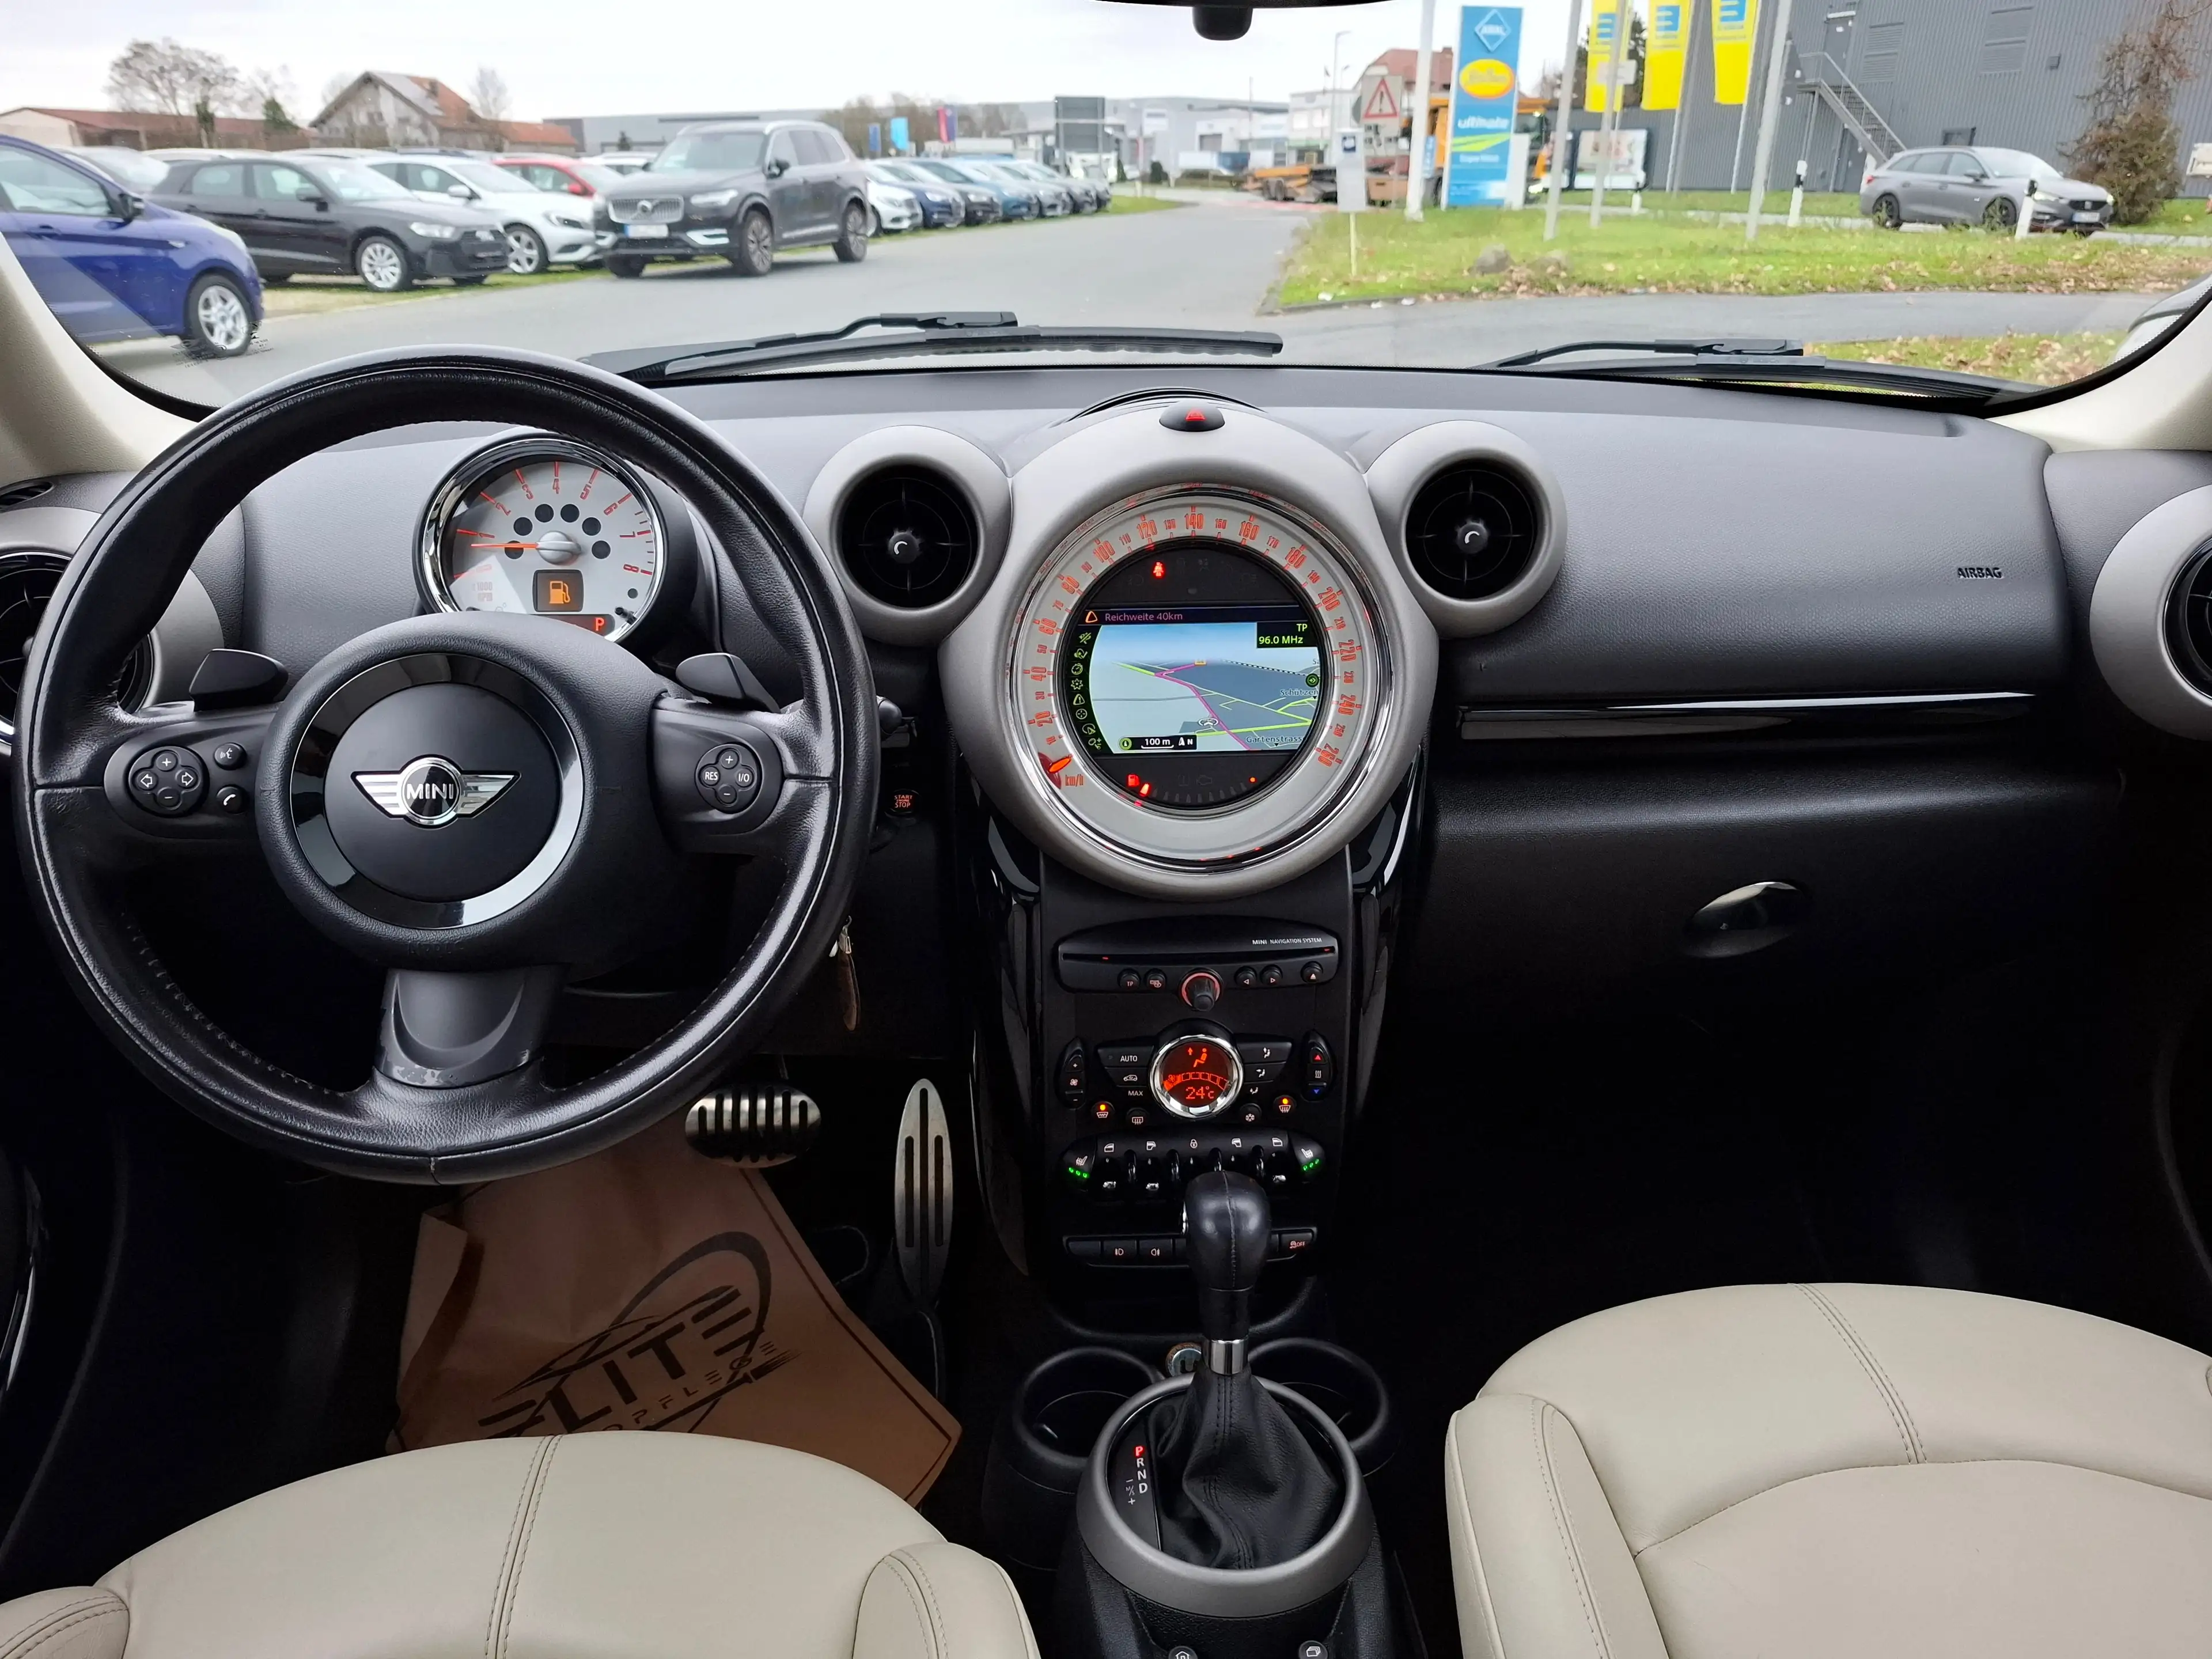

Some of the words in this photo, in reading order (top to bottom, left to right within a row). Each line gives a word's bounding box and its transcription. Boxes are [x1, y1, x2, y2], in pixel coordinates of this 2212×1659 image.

[521, 484, 533, 500] 3
[552, 479, 559, 494] 4
[579, 484, 591, 500] 5
[495, 502, 512, 516] 2
[603, 503, 619, 516] 6
[1184, 513, 1204, 529] 140
[1137, 520, 1158, 540] 120
[1238, 521, 1260, 540] 160
[1093, 540, 1116, 563] 100
[1285, 547, 1307, 569] 180
[623, 563, 640, 574] 8
[1957, 567, 2003, 579] AIRBAG
[1061, 575, 1080, 594] 80
[1317, 586, 1341, 611] 200
[595, 618, 604, 631] P
[1105, 612, 1154, 622] Reichweite
[1156, 612, 1183, 620] 40km
[1038, 618, 1058, 635] 60
[1297, 623, 1308, 632] TP
[1259, 636, 1279, 645] 96.0
[1282, 635, 1304, 645] MHz
[1338, 639, 1357, 662] 220
[1031, 666, 1047, 681] 40
[1338, 694, 1357, 715] 240
[1035, 711, 1053, 727] 20
[1318, 743, 1340, 767] 260
[704, 771, 718, 781] RES
[1065, 774, 1084, 787] km/h
[406, 783, 454, 800] MINI
[1135, 1446, 1143, 1457] P
[1137, 1457, 1145, 1468] R
[1137, 1469, 1146, 1480] N
[1138, 1483, 1148, 1494] D
